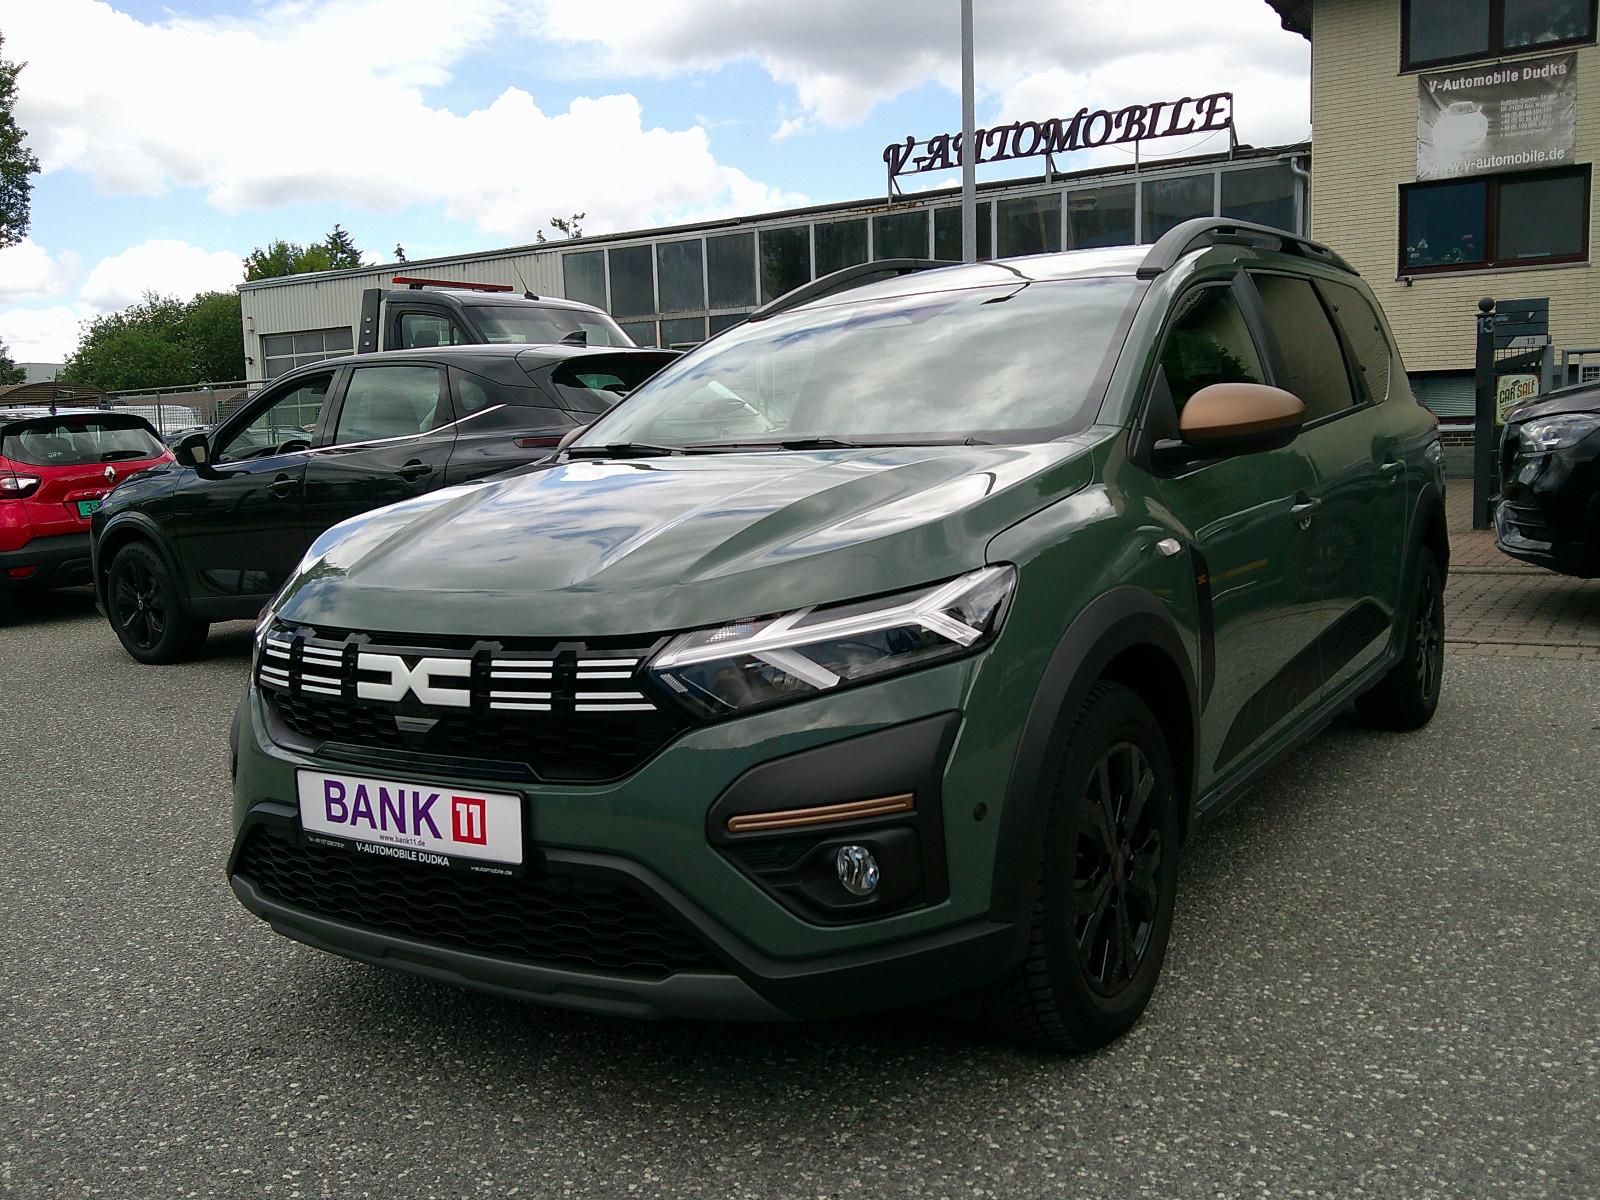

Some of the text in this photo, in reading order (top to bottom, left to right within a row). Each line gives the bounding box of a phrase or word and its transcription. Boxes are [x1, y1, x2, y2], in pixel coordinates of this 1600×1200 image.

[1429, 63, 1567, 92] V-Automobile Dudka
[883, 92, 1233, 175] V-AUTOMOBILE
[1479, 317, 1494, 334] 13
[1500, 380, 1535, 403] CAR SALE
[323, 779, 482, 840] BANK 11
[379, 834, 426, 847] www.bank11.de
[356, 842, 417, 861] V-AUTOMOBILE
[418, 852, 450, 867] DUDKA
